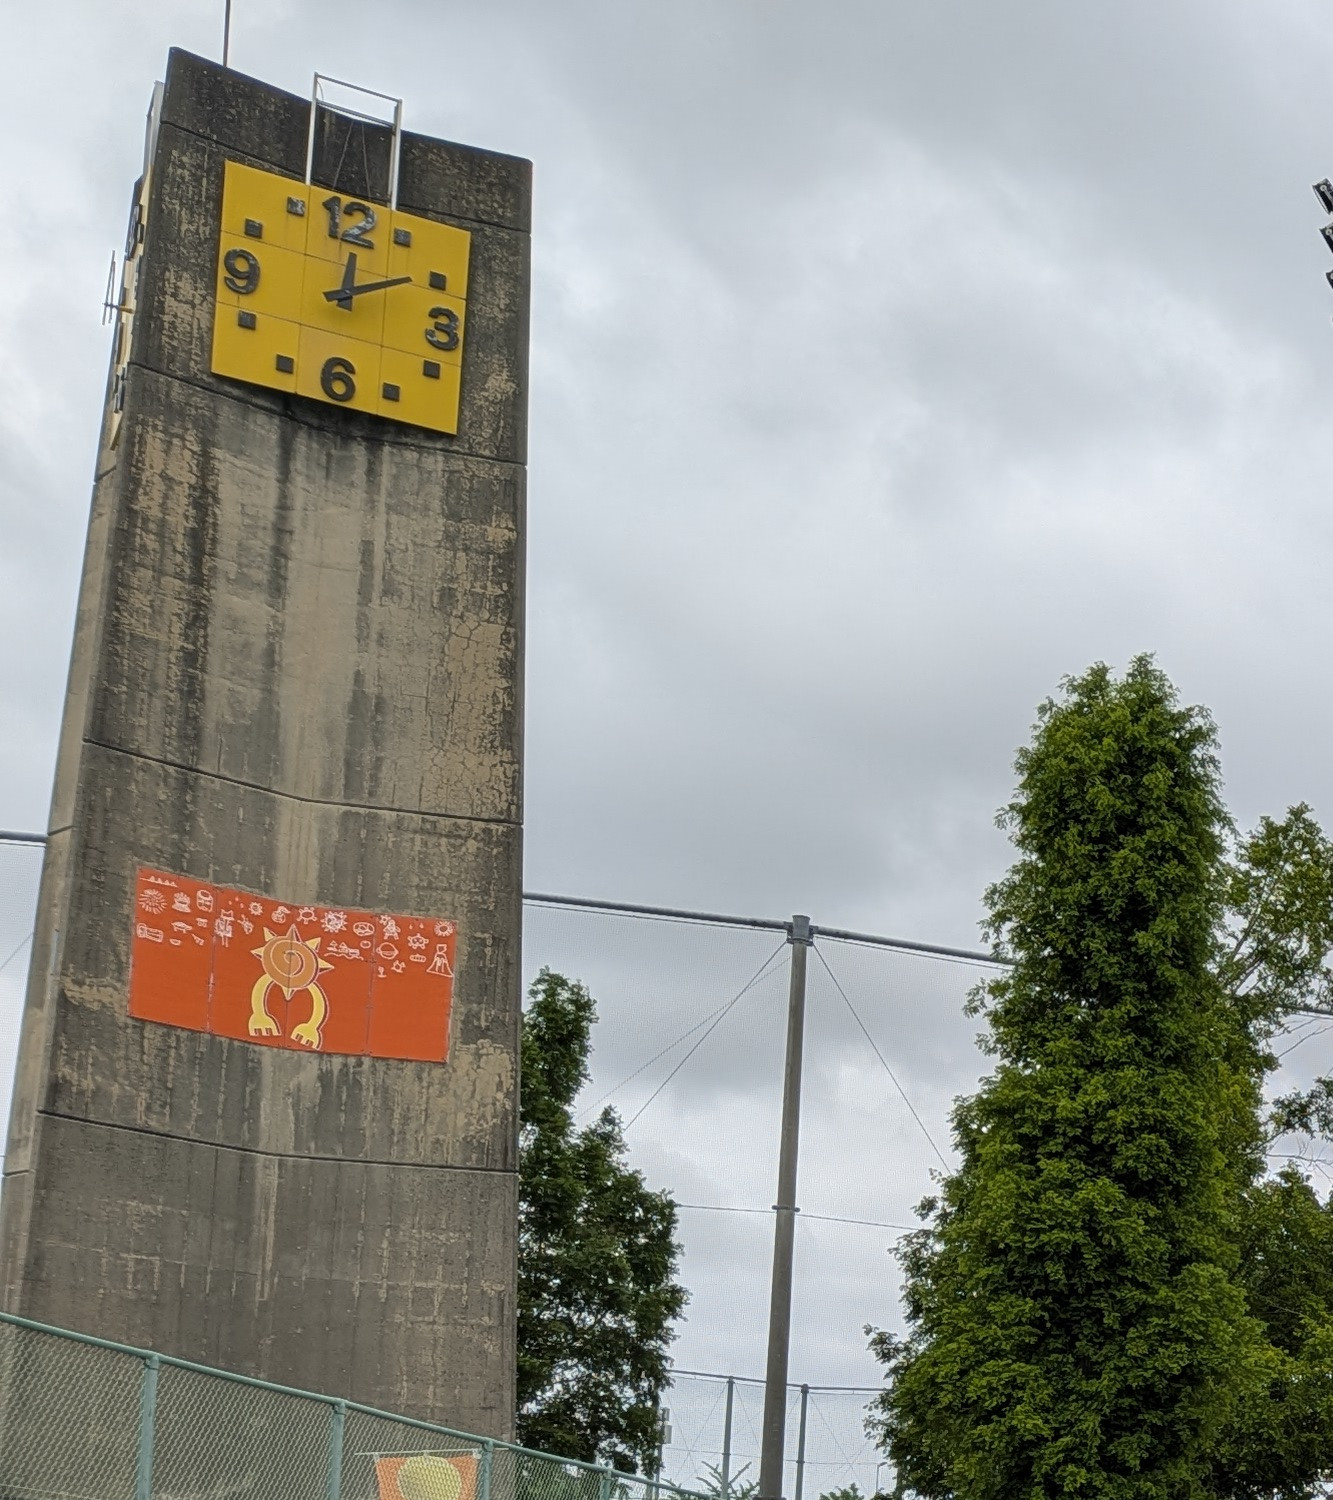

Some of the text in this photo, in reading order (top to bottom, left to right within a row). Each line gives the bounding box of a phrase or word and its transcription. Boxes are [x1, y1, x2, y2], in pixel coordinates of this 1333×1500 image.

[322, 196, 378, 249] 12
[223, 248, 261, 294] 9
[425, 308, 459, 351] 3
[320, 357, 356, 401] 6
